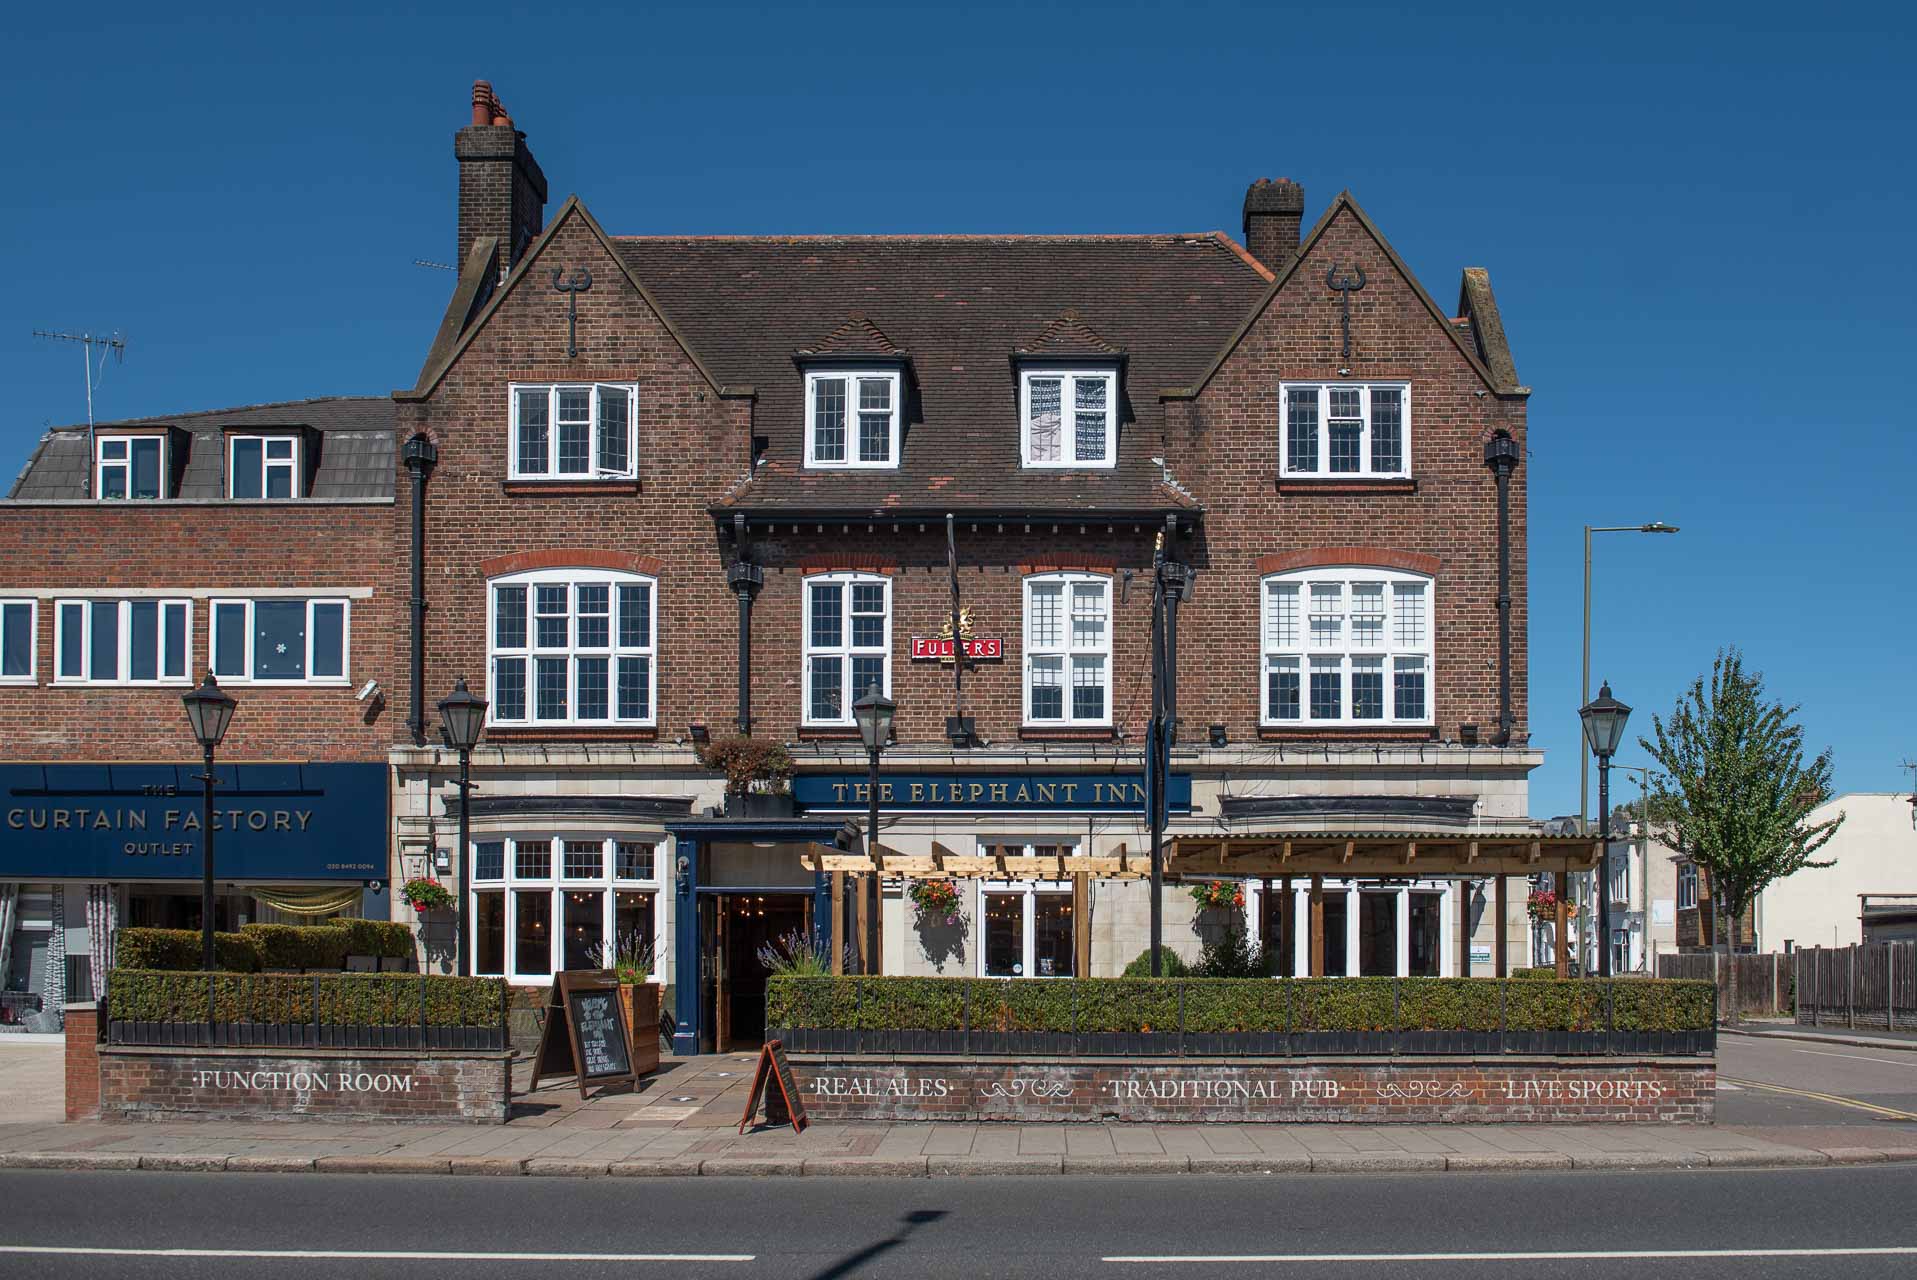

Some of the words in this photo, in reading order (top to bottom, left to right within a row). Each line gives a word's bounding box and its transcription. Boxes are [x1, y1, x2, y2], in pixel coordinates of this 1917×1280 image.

[141, 784, 176, 796] THE
[832, 783, 894, 802] THE
[909, 783, 1078, 802] ELEPHANT
[7, 808, 147, 829] CURTAIN
[164, 808, 313, 831] FACTORY
[124, 842, 193, 855] OUTLET
[199, 1070, 330, 1091] FUNCTION
[337, 1072, 413, 1093] ROOM
[815, 1077, 880, 1096] REAL
[885, 1078, 948, 1097] ALES
[1108, 1079, 1282, 1098] TRADITIONAL
[1290, 1080, 1339, 1098] PUB
[1505, 1080, 1563, 1099] LIVE
[1568, 1080, 1662, 1099] SPORTS
